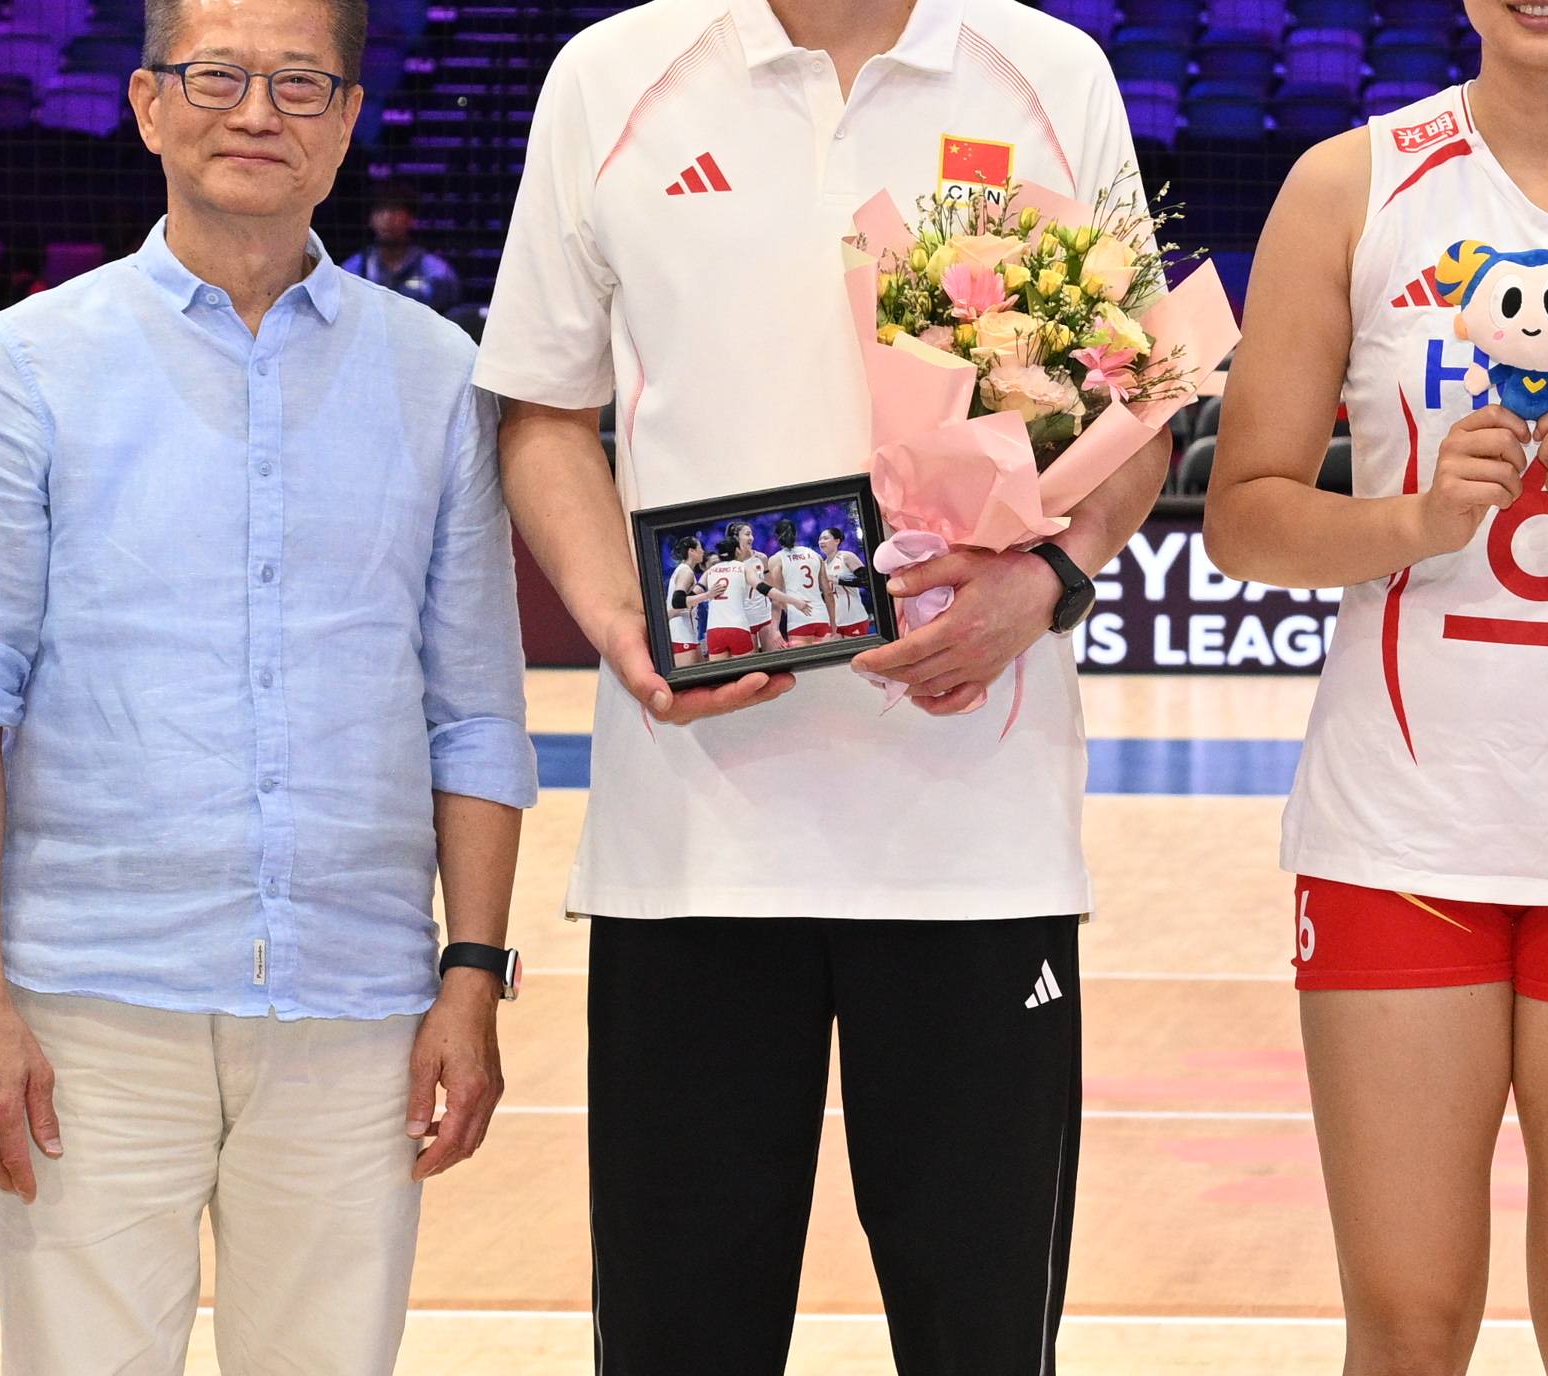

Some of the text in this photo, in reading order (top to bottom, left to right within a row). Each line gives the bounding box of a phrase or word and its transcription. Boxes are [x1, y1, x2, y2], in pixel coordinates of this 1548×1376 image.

[1398, 114, 1455, 144] 光明
[800, 565, 814, 589] 3
[1153, 613, 1336, 666] LEAG
[1299, 890, 1316, 962] 6
